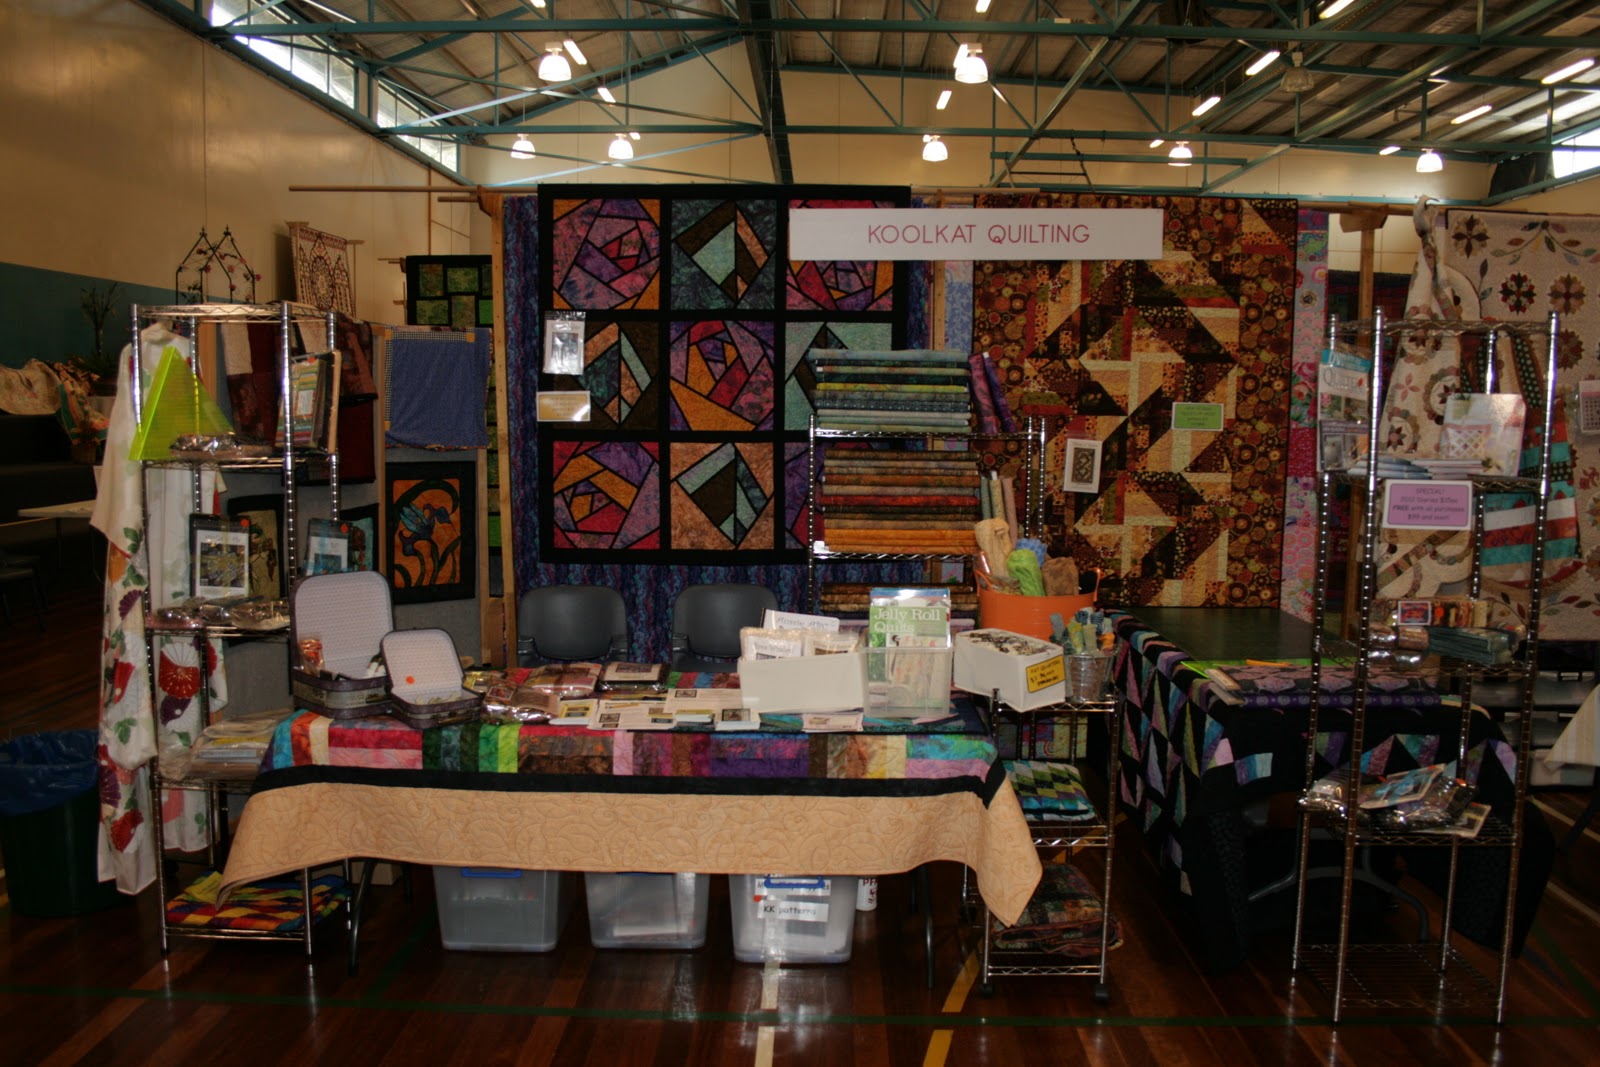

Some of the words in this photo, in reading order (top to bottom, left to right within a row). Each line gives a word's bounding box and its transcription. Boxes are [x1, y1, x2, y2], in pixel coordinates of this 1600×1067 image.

[868, 224, 976, 244] KOOLKAT
[988, 224, 1090, 244] QUILTING
[1392, 504, 1409, 512] FREE
[874, 608, 908, 622] Jelly
[911, 608, 941, 620] Roll
[874, 621, 914, 633] Quilts
[763, 905, 775, 914] KK
[778, 906, 817, 916] patterns
